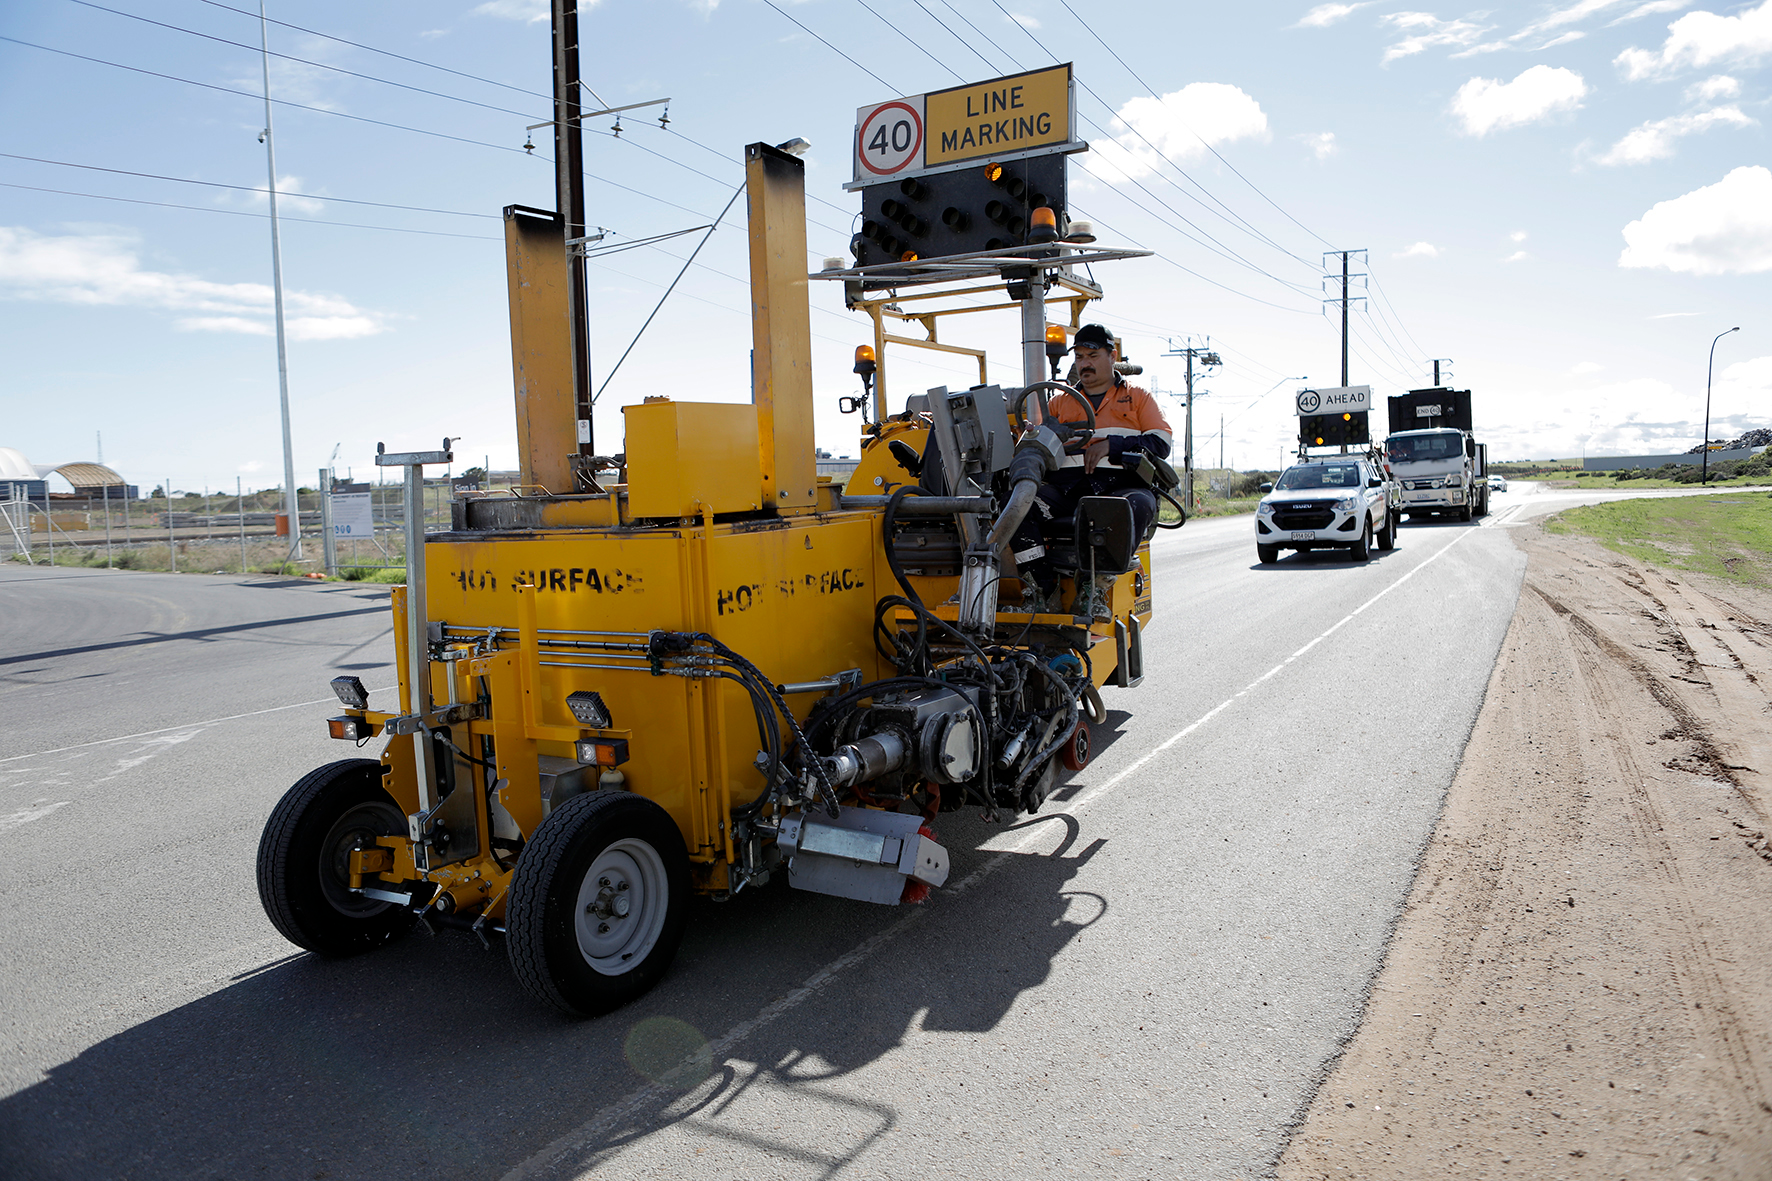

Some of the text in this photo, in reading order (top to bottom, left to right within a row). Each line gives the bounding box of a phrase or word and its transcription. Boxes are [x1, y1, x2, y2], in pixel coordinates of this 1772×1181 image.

[967, 85, 1024, 118] LINE
[868, 119, 911, 155] 40
[941, 112, 1052, 153] MARKING
[1300, 392, 1365, 407] 40 AHEAD
[511, 567, 645, 594] SURFACE
